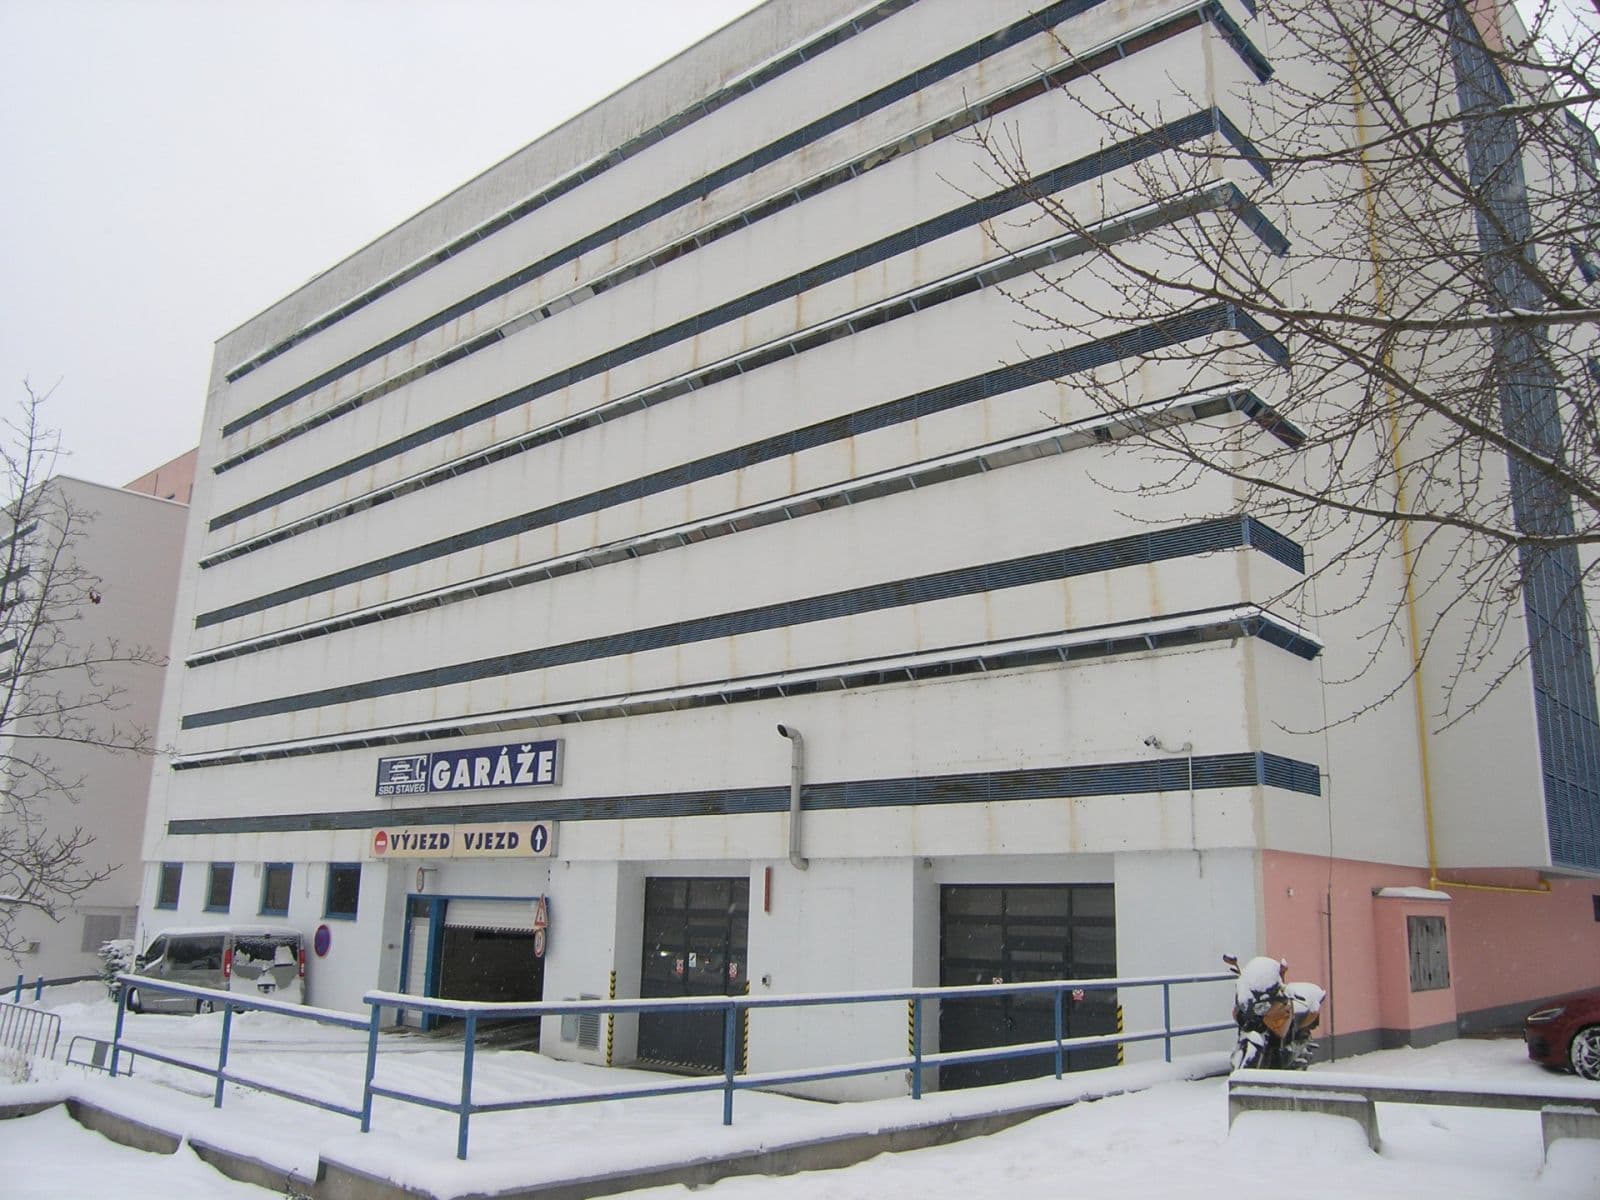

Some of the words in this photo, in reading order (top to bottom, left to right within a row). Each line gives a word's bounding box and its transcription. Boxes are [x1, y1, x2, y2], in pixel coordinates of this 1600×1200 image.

[432, 744, 553, 789] GARÁŽE
[378, 785, 394, 795] SBD
[395, 783, 425, 794] STAVEG
[391, 830, 450, 850] VÝJEZD
[464, 832, 519, 850] VJEZD
